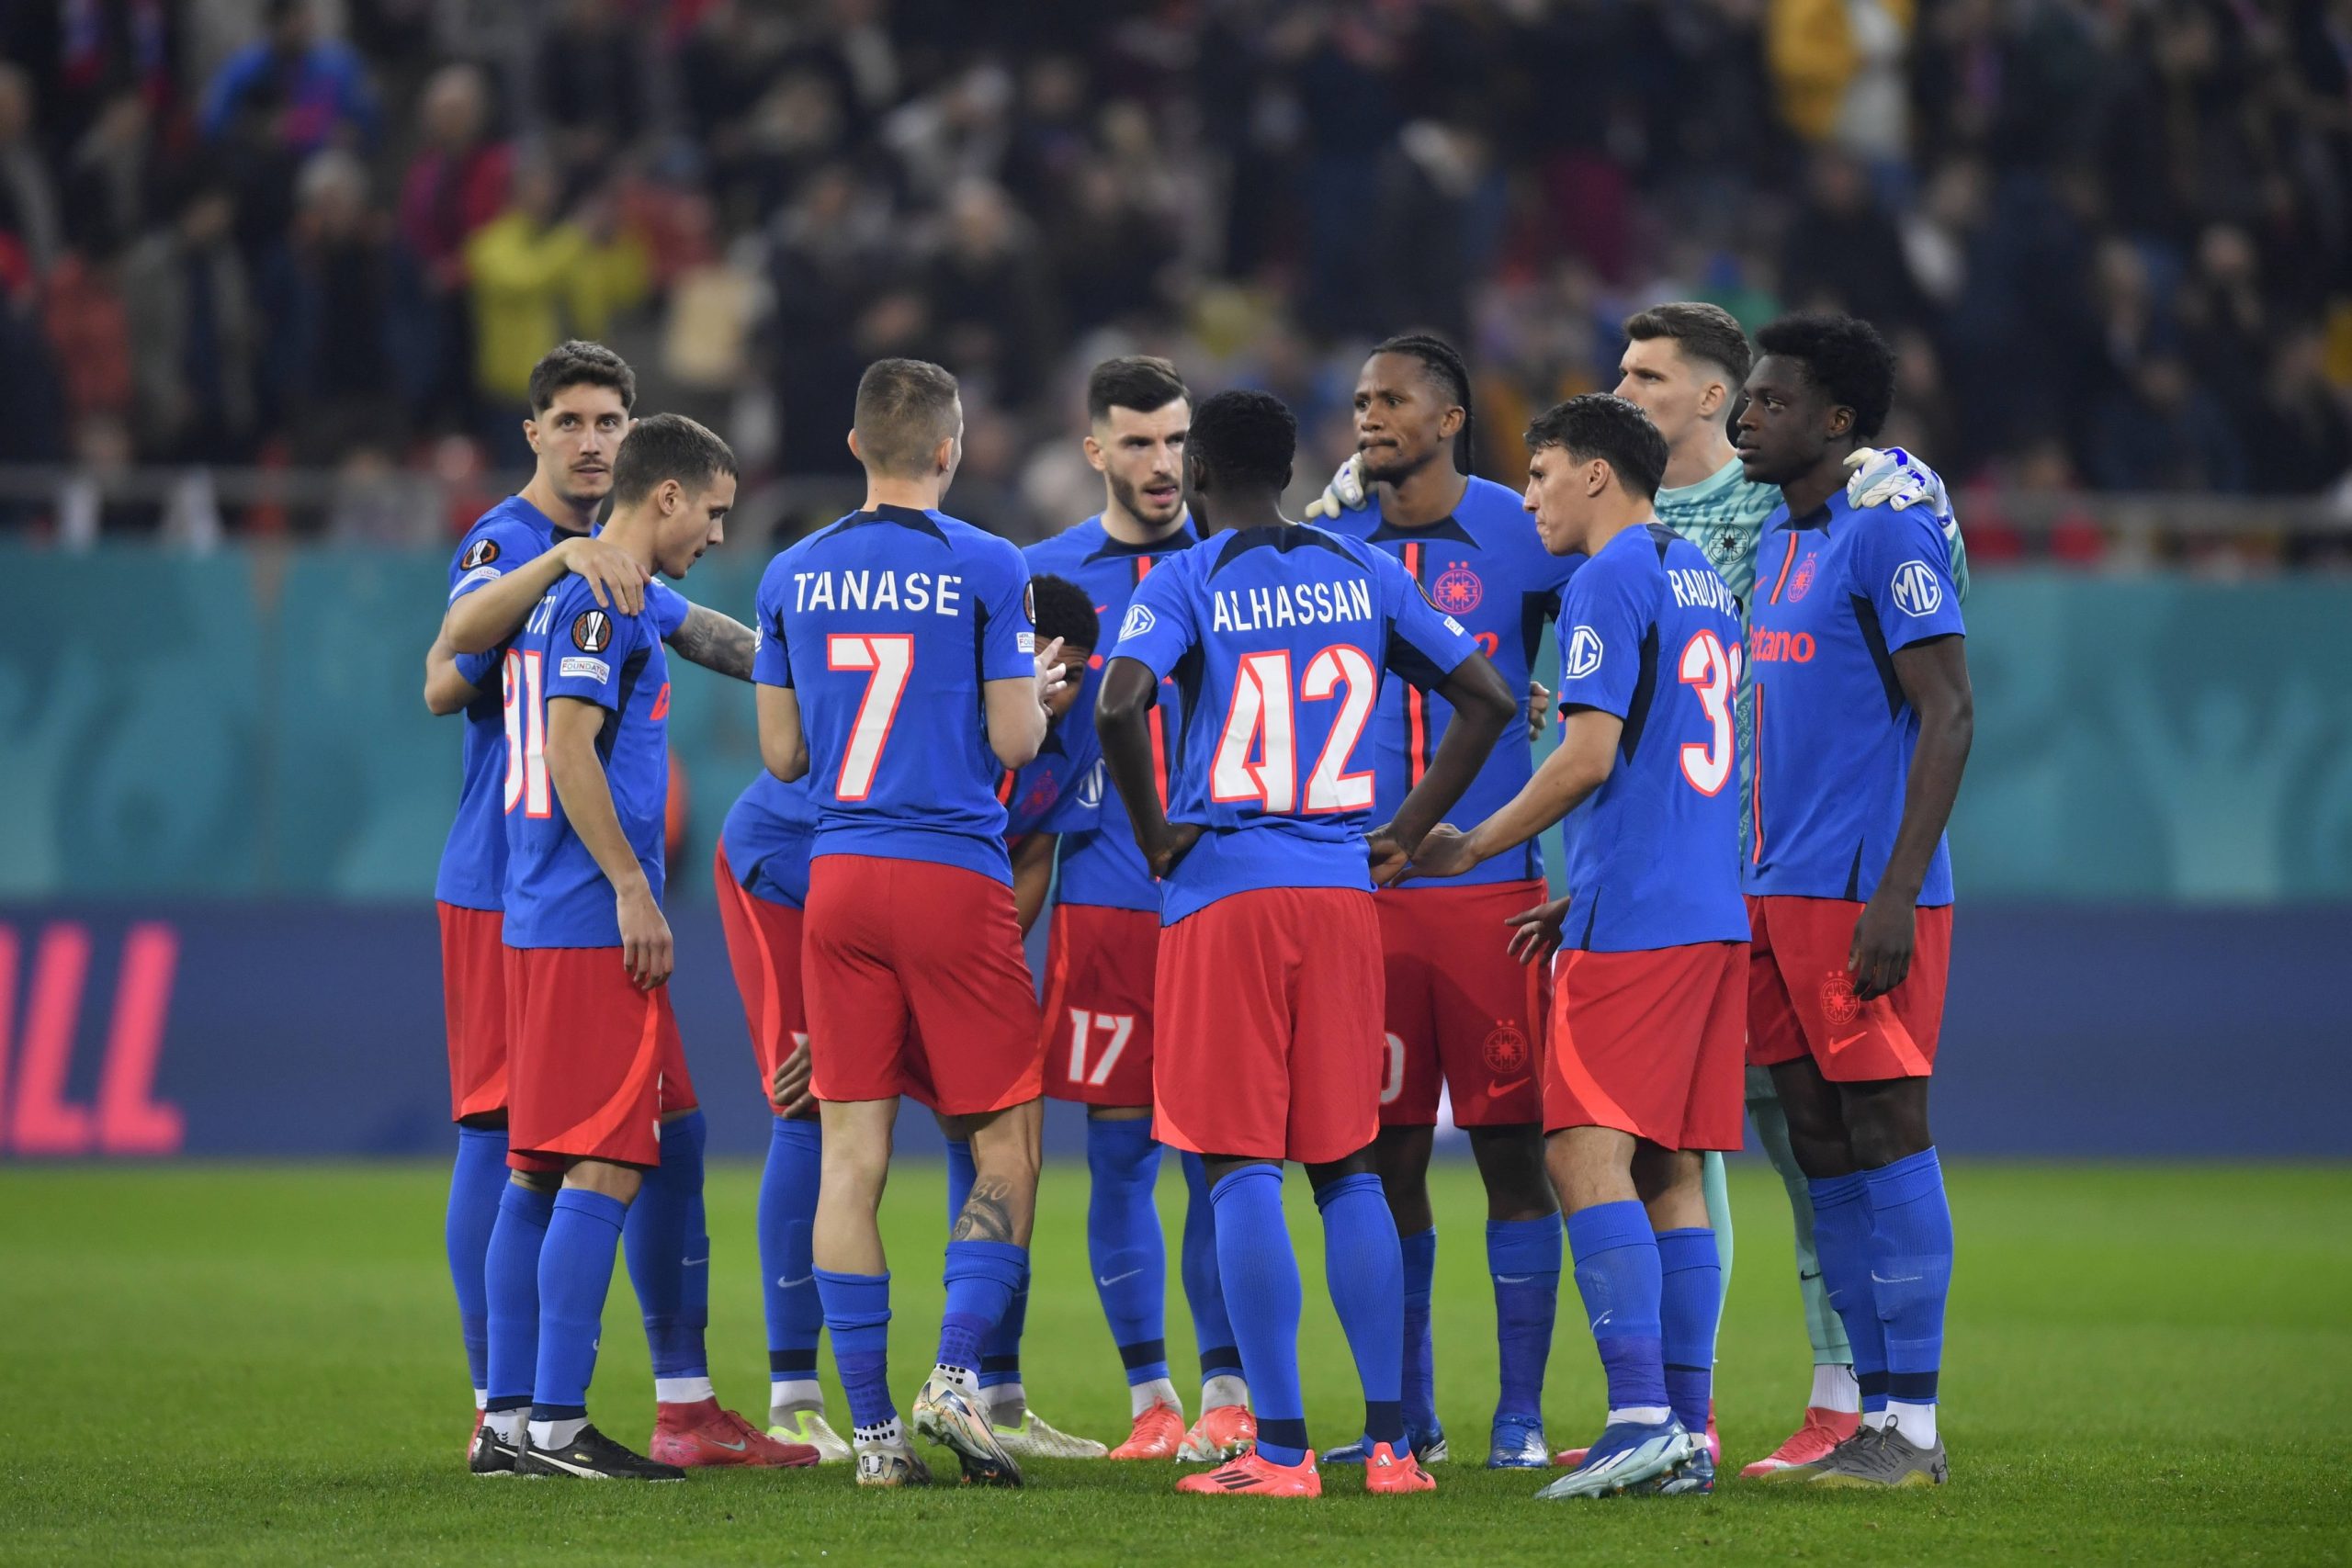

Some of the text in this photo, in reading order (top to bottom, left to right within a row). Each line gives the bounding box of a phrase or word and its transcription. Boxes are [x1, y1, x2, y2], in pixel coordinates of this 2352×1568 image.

[794, 570, 962, 616] TANASE
[1213, 579, 1373, 632] ALHASSAN
[1894, 564, 1939, 613] MG
[1749, 625, 1815, 662] etano
[827, 634, 914, 801] 7
[1210, 644, 1374, 815] 42
[0, 920, 185, 1156] LL
[1068, 1007, 1134, 1086] 17
